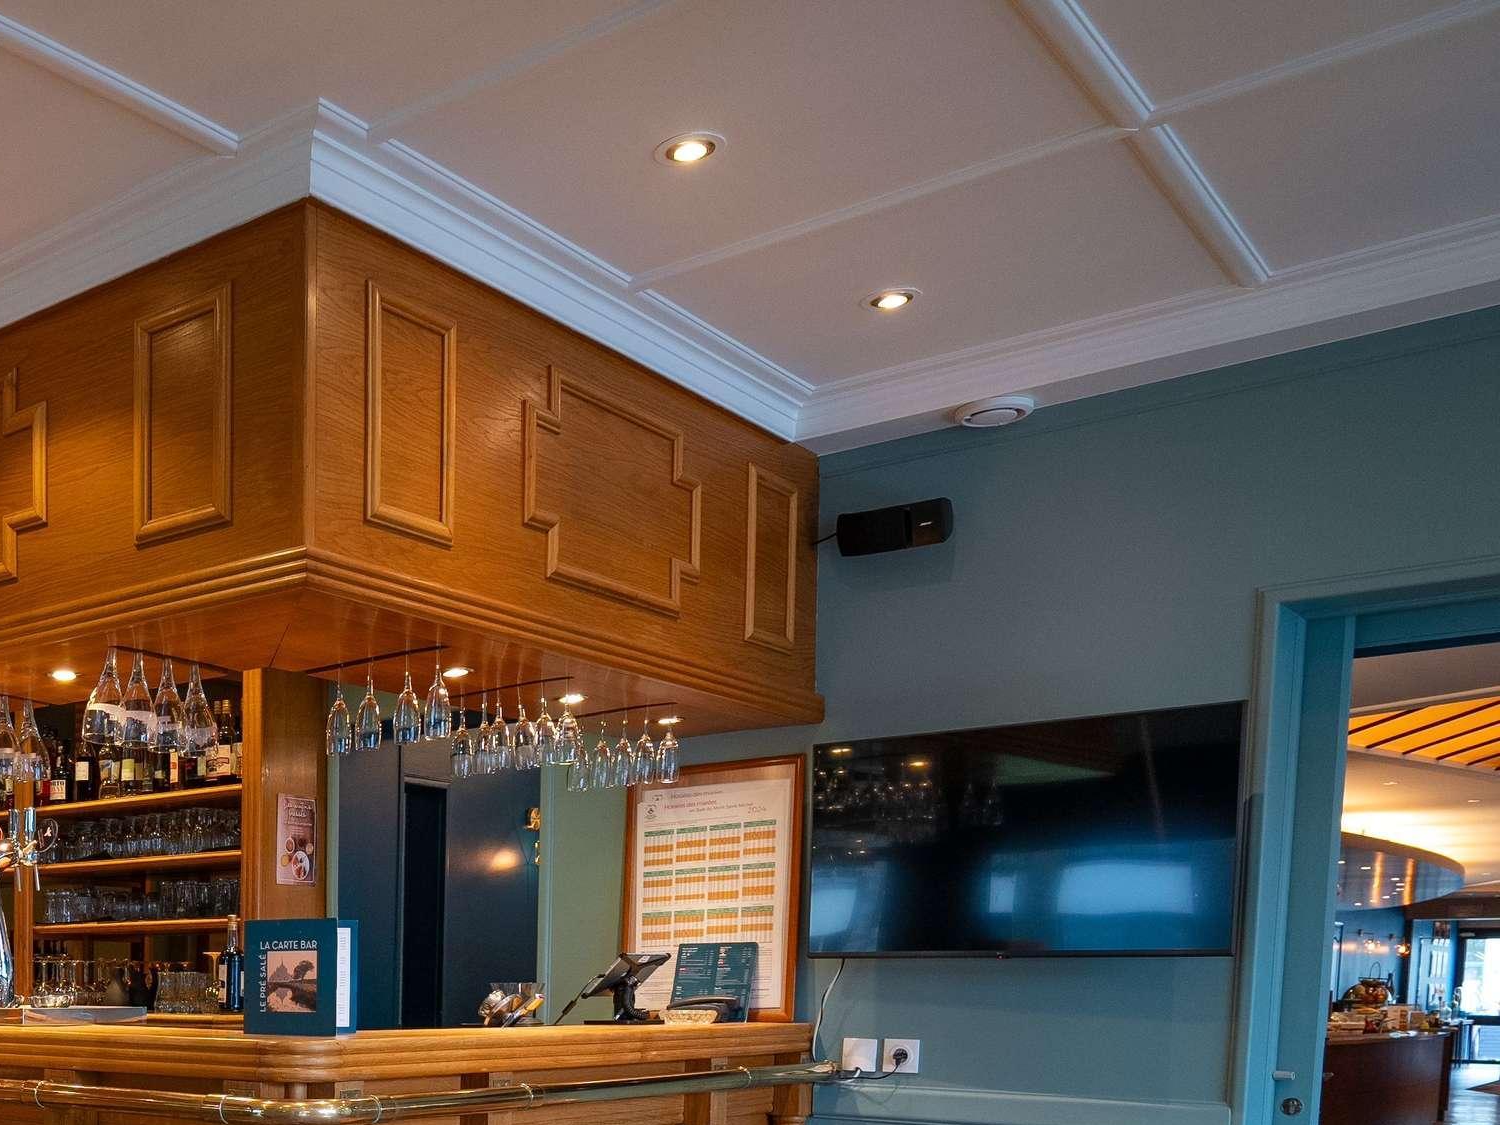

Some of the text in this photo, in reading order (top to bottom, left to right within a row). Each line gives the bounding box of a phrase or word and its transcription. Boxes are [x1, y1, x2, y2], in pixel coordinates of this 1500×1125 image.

[259, 940, 318, 950] LA CARTE BAR
[260, 1001, 267, 1013] LE
